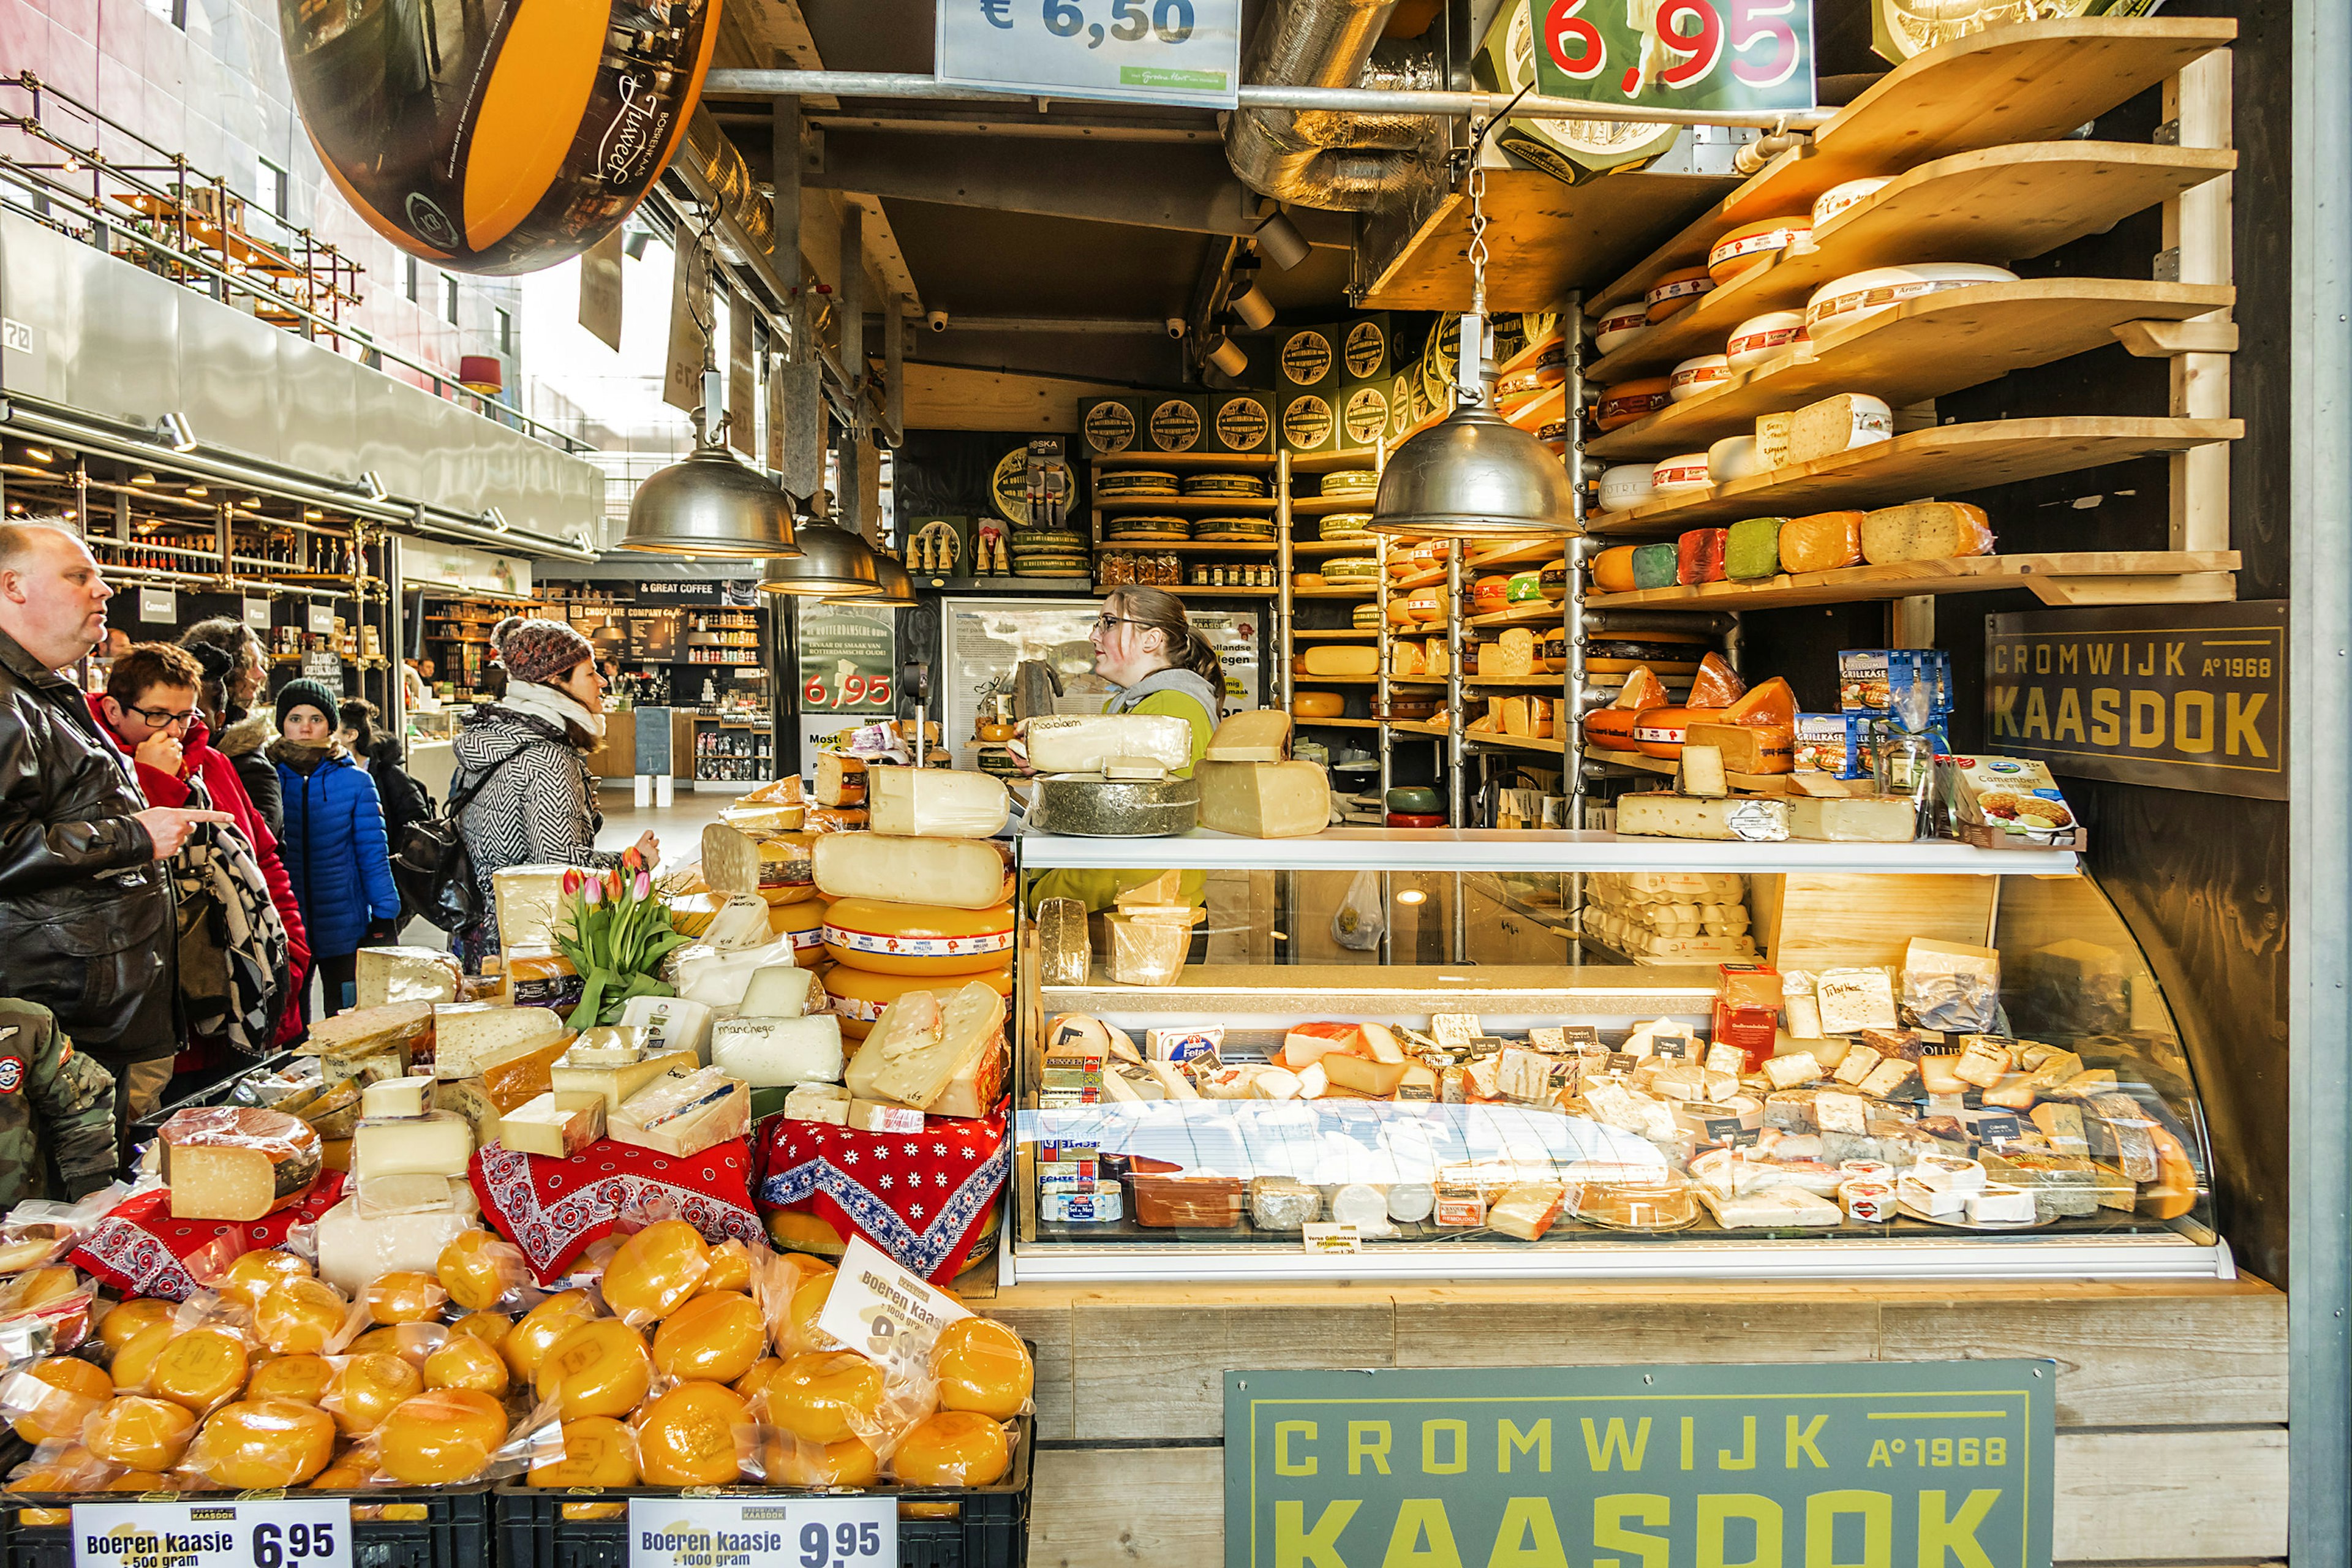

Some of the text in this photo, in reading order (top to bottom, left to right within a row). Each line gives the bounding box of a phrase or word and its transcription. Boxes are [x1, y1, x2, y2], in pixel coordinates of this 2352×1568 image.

[1042, 0, 1194, 49] 6,50
[1545, 0, 1800, 99] 6,95
[635, 111, 669, 177] BOERENKAAS
[1899, 285, 1923, 294] Arina
[1838, 295, 1858, 305] Arina
[4, 322, 30, 349] 70
[1768, 332, 1788, 341] Arina
[641, 583, 713, 594] & GREAT COFFEE
[145, 601, 172, 612] Cannoli
[628, 608, 662, 617] COMPANY
[816, 625, 870, 636] ROTTERDAMSCHE
[872, 628, 888, 637] OUDE
[1218, 655, 1250, 666] legen
[1994, 641, 2185, 677] CROMWIJK
[1842, 669, 1887, 679] GRILLKÄSE
[804, 674, 892, 709] 6,95
[1033, 719, 1082, 731] hooibloem
[1994, 685, 2269, 758] KAASDOK
[1796, 733, 1844, 742] GRILLKÄSE
[1978, 775, 2043, 785] Camembert
[718, 1022, 776, 1039] manchego
[1183, 1049, 1205, 1058] Feta
[1921, 1045, 1961, 1056] OLLIE
[862, 1270, 908, 1310] Boeren
[887, 1304, 905, 1321] 1000
[1275, 1414, 1830, 1477] CROMWIJK
[1275, 1488, 2003, 1568] KAASDOK
[87, 1534, 159, 1555] Boeren
[165, 1531, 233, 1553] kaasje
[642, 1531, 711, 1551] Boeren
[717, 1531, 782, 1553] kaasje
[133, 1557, 157, 1568] 500
[162, 1554, 198, 1568] gram
[682, 1555, 712, 1566] 1000
[715, 1553, 750, 1568] gram
